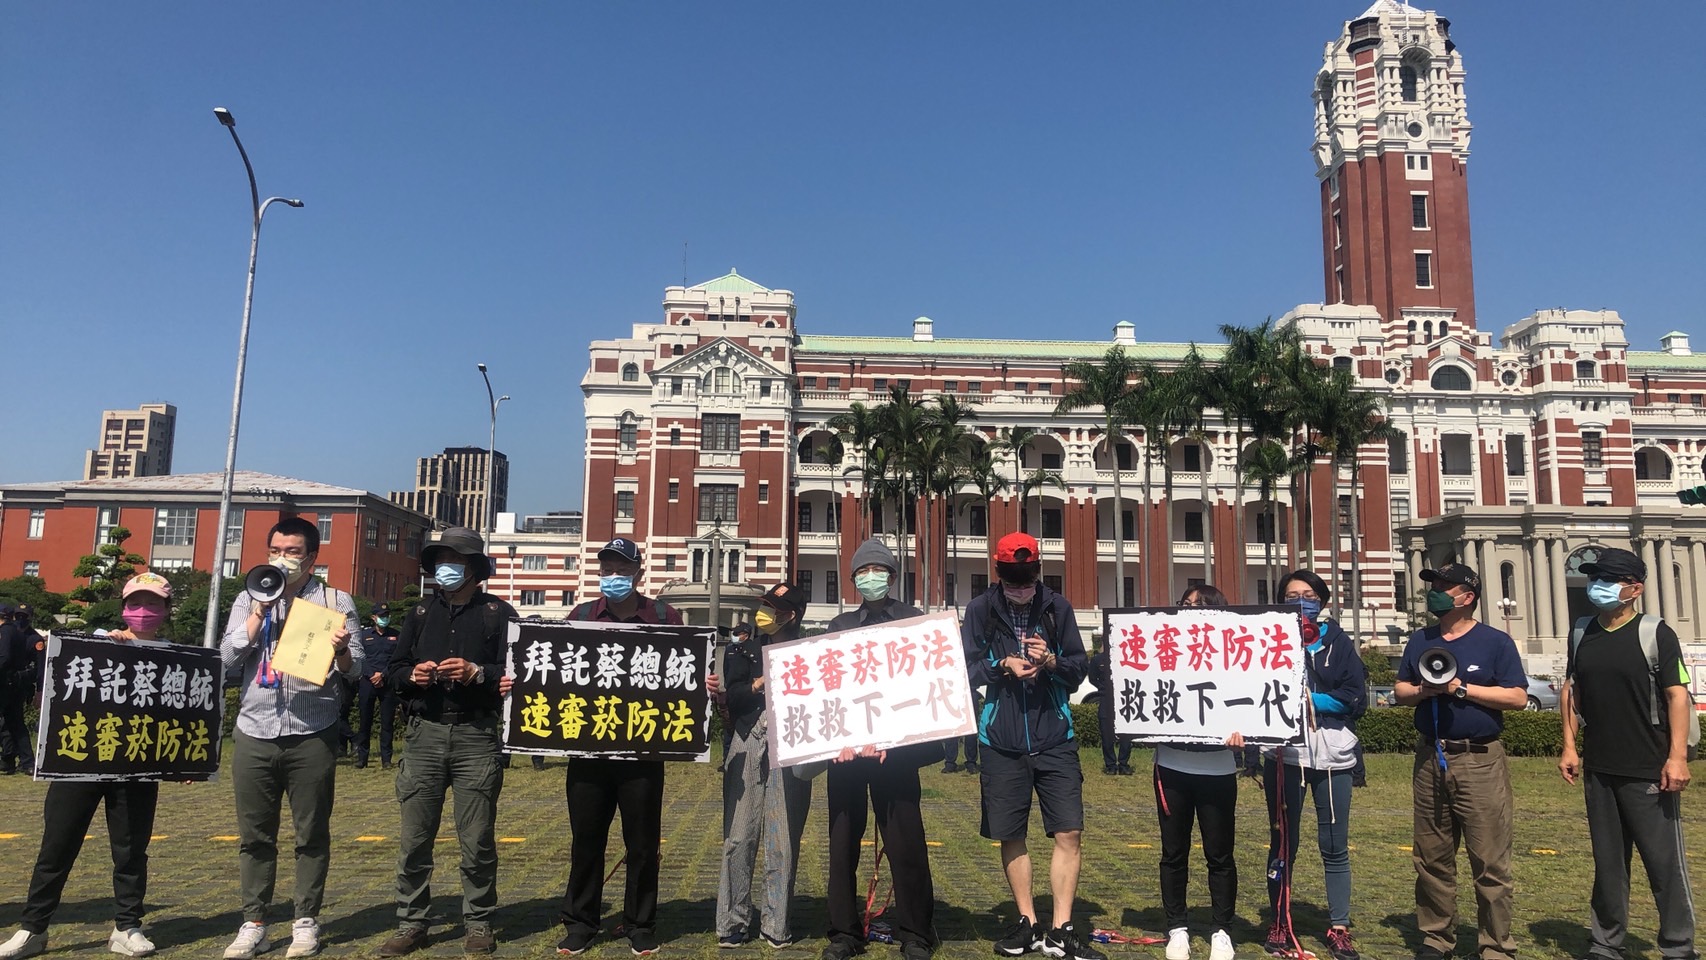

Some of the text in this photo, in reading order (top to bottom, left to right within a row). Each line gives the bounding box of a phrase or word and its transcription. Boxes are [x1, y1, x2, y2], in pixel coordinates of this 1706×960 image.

[522, 639, 698, 691] 拜託蔡總統
[780, 629, 955, 696] 速審菸防法
[1118, 623, 1294, 672] 速審菸防法
[62, 655, 214, 711] 拜託蔡總統
[1119, 678, 1296, 729] 救救下一代
[56, 710, 211, 763] 速審菸防法
[520, 691, 695, 743] 速審菸防法
[782, 677, 962, 748] 救救下一代
